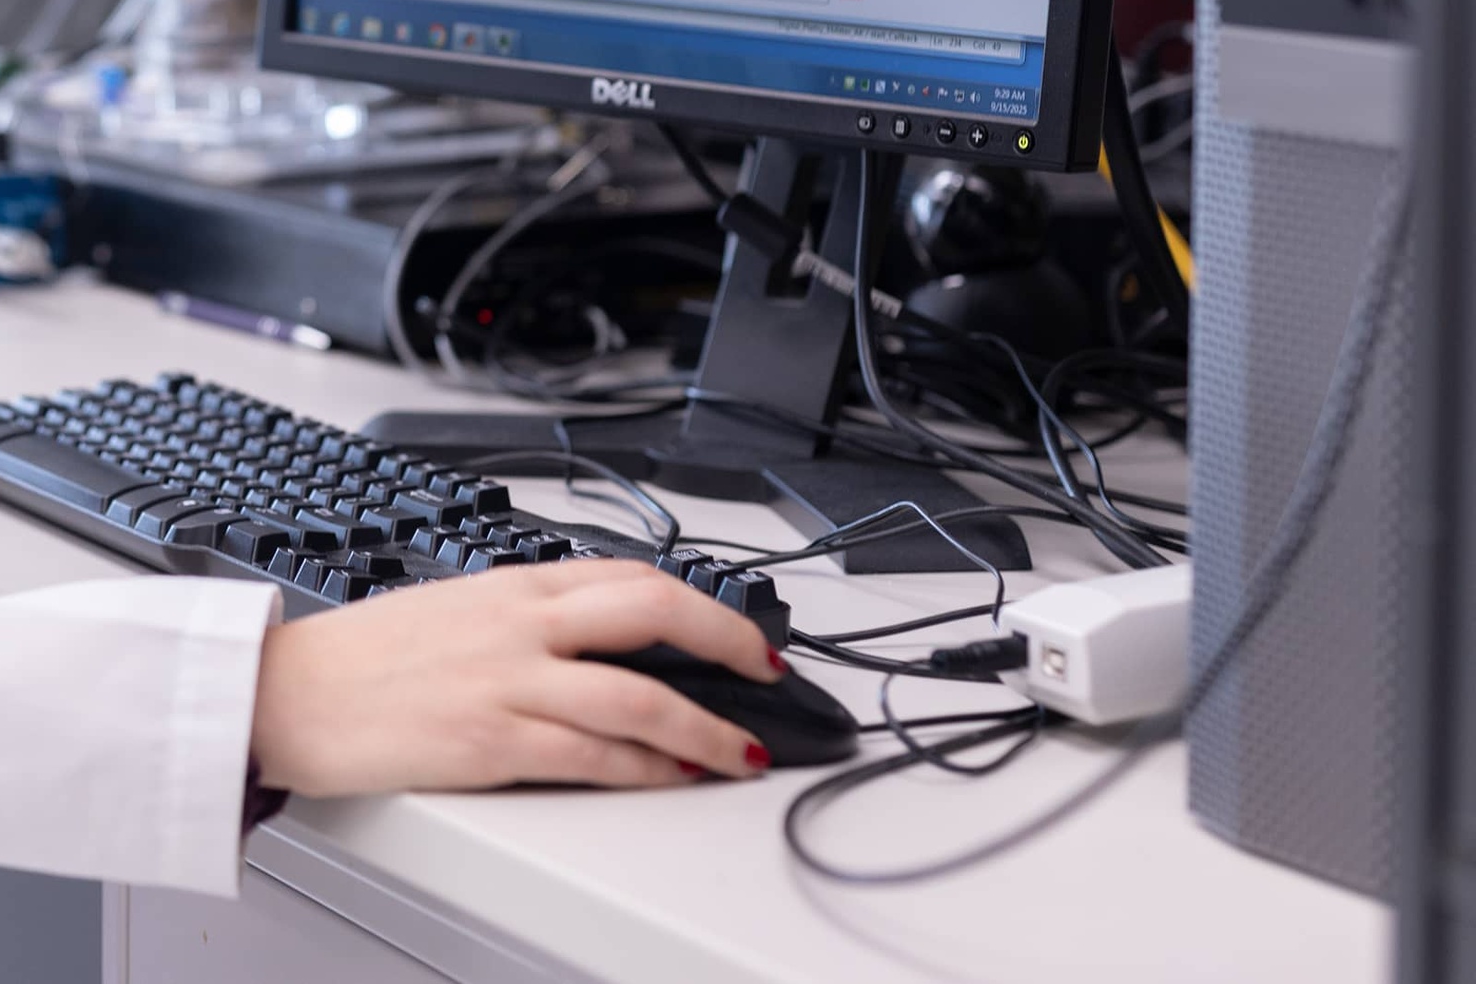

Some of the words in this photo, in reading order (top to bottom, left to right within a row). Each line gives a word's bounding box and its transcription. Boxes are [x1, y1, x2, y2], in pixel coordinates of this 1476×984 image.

[591, 77, 656, 109] DELL
[994, 87, 1011, 99] 9:29
[1011, 90, 1025, 101] AM
[990, 101, 1028, 115] 9/15/2025
